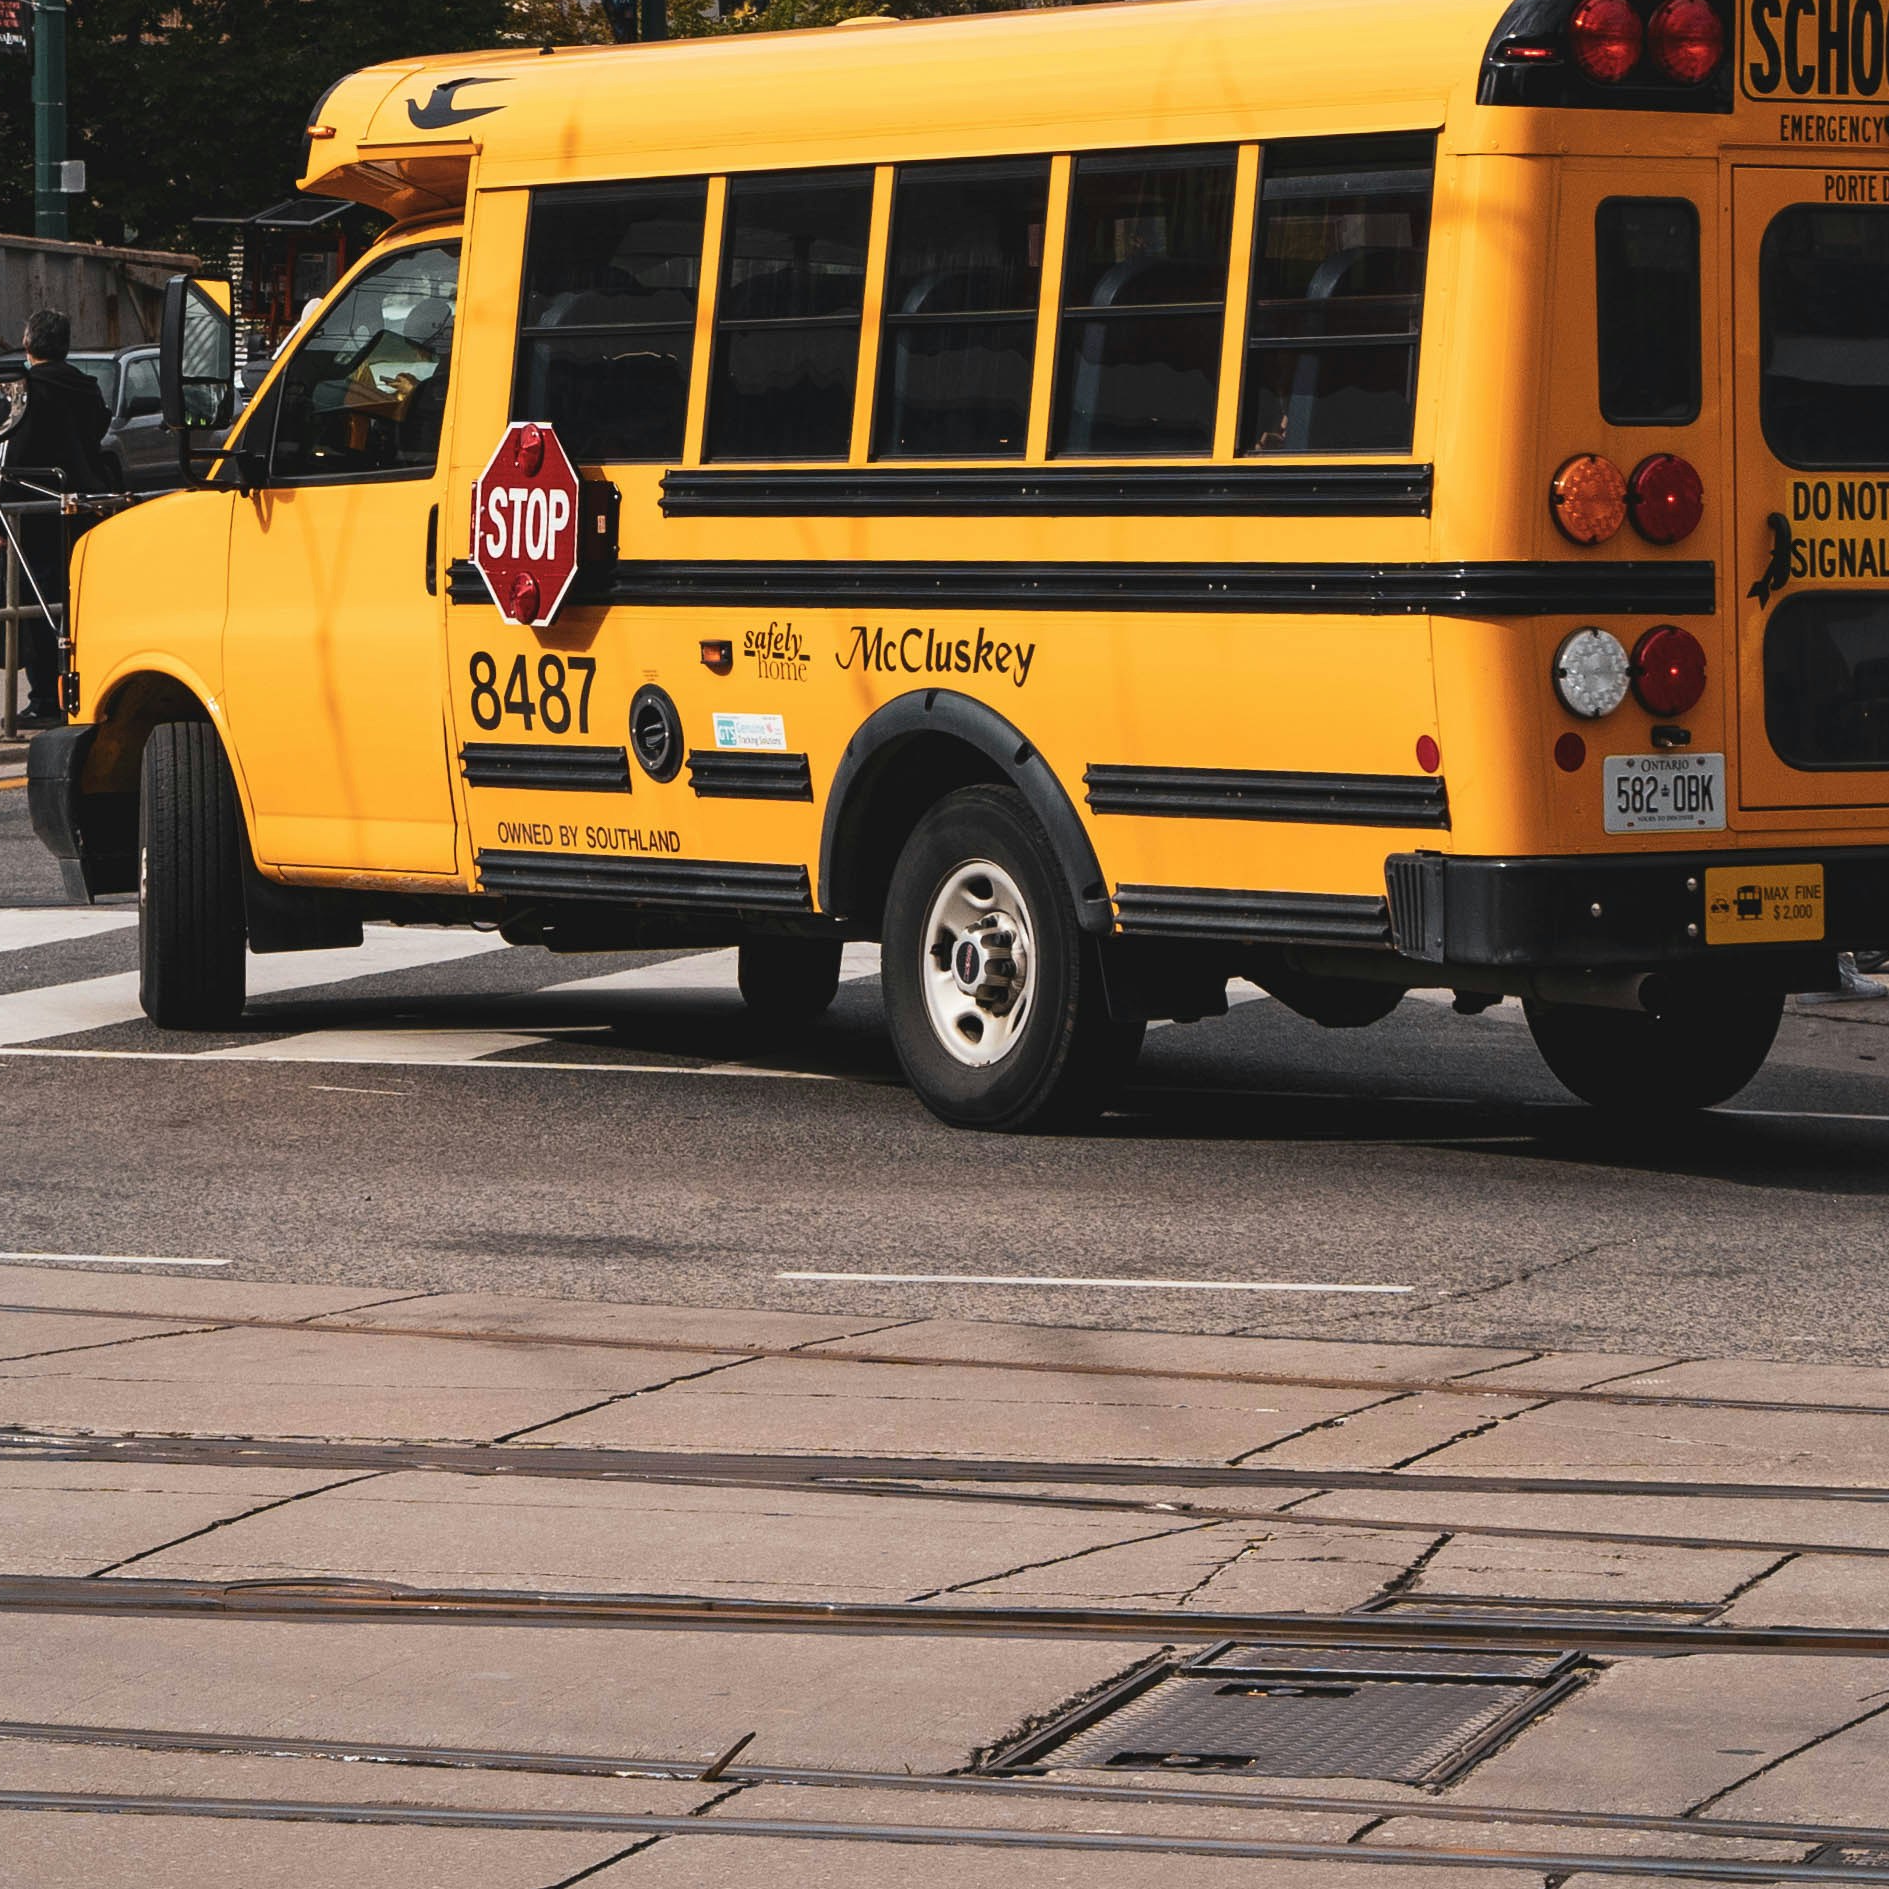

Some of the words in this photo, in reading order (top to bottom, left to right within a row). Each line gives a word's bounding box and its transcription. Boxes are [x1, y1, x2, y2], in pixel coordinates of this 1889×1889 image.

[1780, 114, 1885, 144] EMERGENCY
[1824, 174, 1877, 202] PORTE
[1793, 481, 1831, 521] DO
[486, 486, 570, 561] STOP
[744, 621, 803, 661] safely
[836, 626, 1036, 688] McCluskey
[757, 650, 807, 683] home
[469, 650, 597, 734] 8487
[1641, 759, 1689, 772] ONTARIO
[1617, 776, 1658, 813] 582
[498, 821, 553, 847] OWNED
[560, 825, 578, 848] BY
[585, 825, 681, 853] SOUTHLAND
[1764, 887, 1789, 900] MAX
[1795, 885, 1822, 900] FINE
[1773, 904, 1780, 921] $
